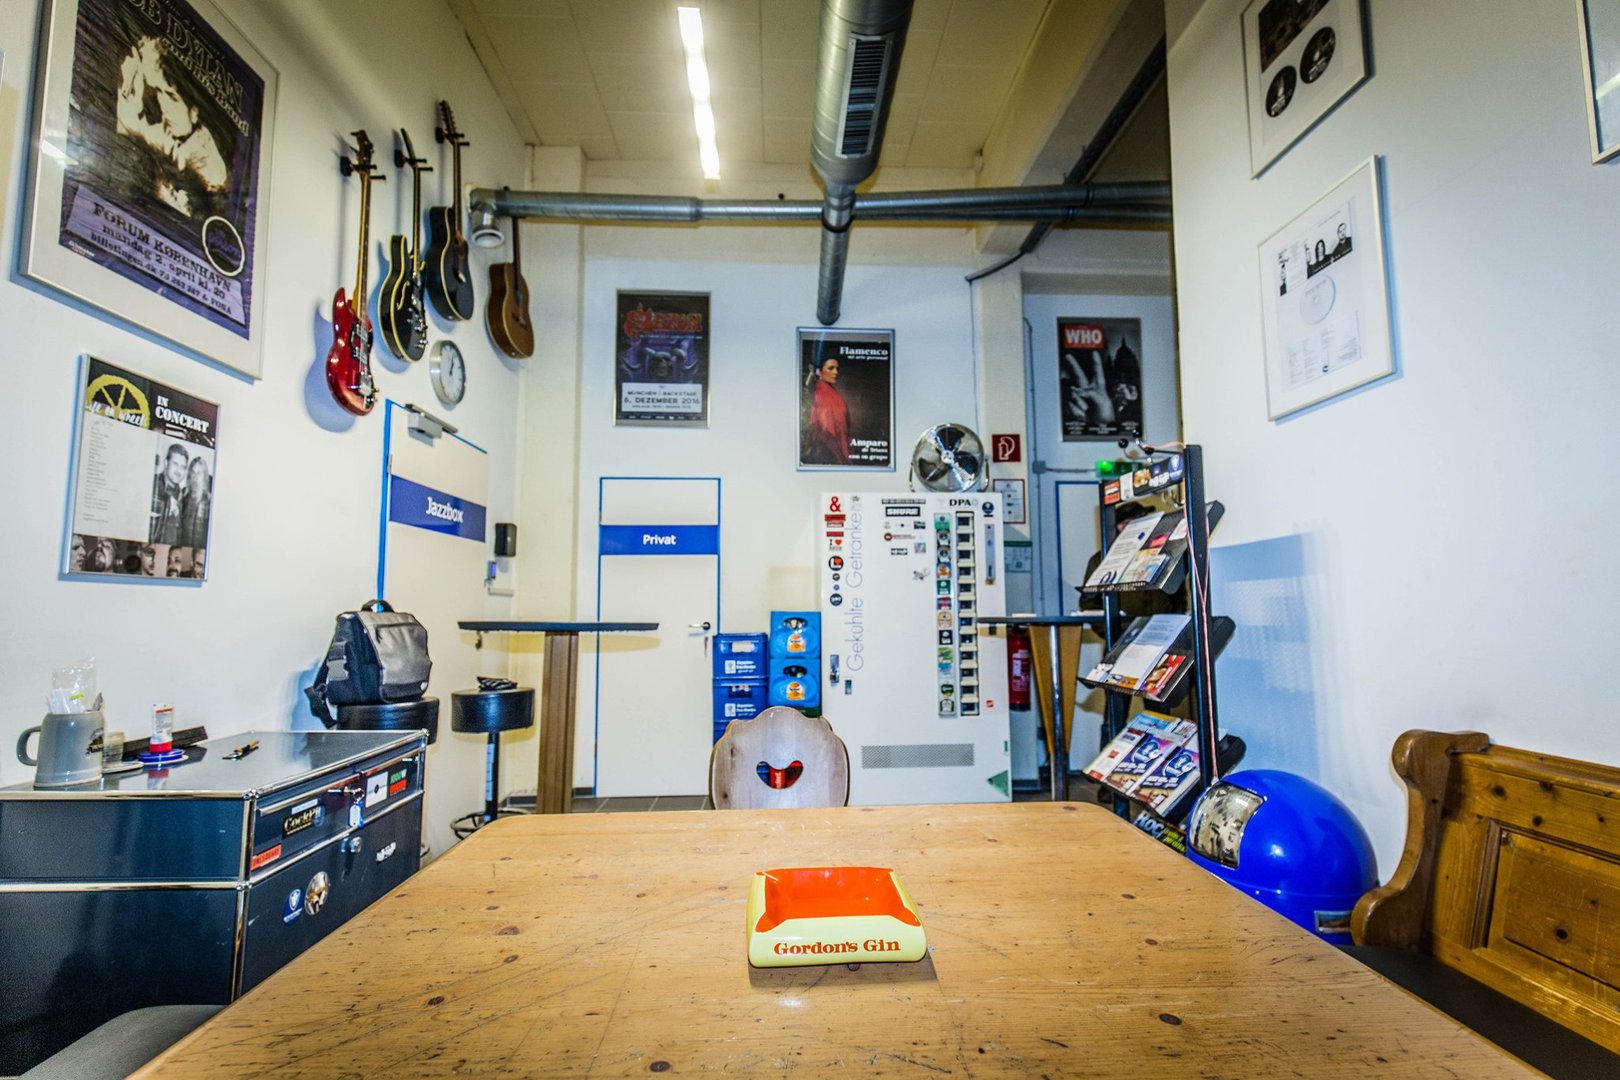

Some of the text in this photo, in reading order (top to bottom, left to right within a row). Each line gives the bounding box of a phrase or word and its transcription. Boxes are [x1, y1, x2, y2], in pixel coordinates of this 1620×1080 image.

[166, 12, 244, 114] DYLAN
[93, 202, 151, 246] FORUM
[154, 239, 231, 293] KØBENHAVN
[103, 224, 153, 261] mandag
[168, 262, 196, 284] april
[213, 285, 226, 300] 20
[1064, 328, 1102, 345] WHO
[840, 346, 888, 356] Flamenco
[156, 395, 169, 408] IN
[155, 406, 210, 434] CONCERT
[850, 438, 888, 449] Amparo
[425, 496, 464, 523] Jazzbox
[949, 499, 972, 507] DPA
[642, 533, 677, 545] Privat
[774, 939, 901, 955] Gordon's Gin
